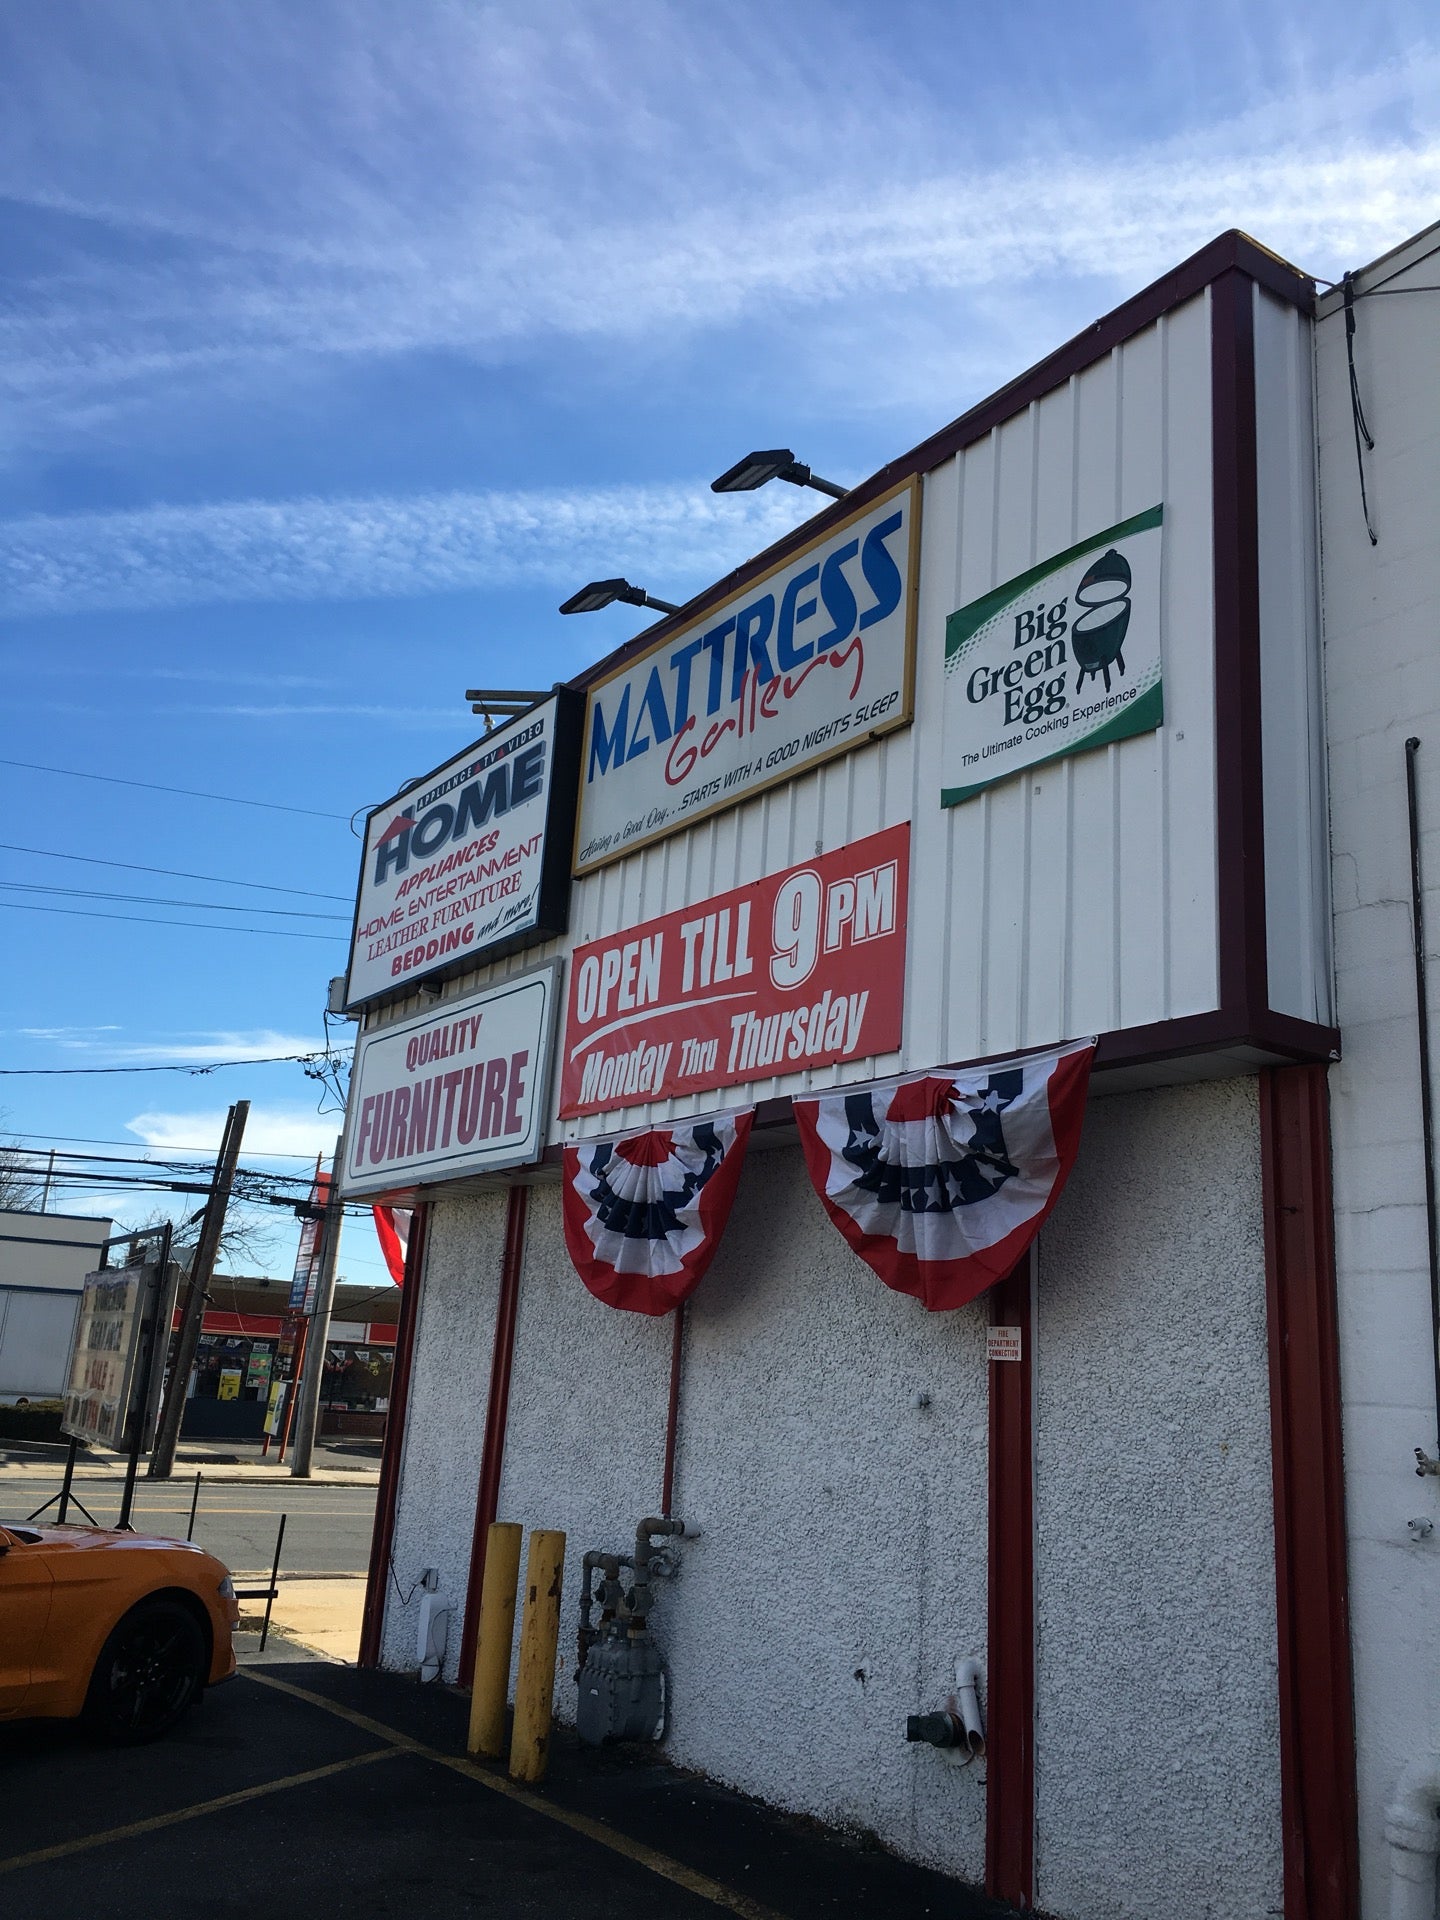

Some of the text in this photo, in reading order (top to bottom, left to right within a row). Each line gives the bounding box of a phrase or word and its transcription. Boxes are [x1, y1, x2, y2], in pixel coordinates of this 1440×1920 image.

[588, 510, 902, 784] MATTRESS
[1013, 597, 1068, 650] Big
[665, 636, 864, 785] Gallery
[966, 640, 1067, 704] Green
[1003, 671, 1067, 726] Egg
[418, 722, 542, 808] APPLIANCE TV VIDEO
[961, 687, 1137, 767] The Ultimate Cooking Experience
[374, 740, 547, 887] HOME
[579, 833, 613, 862] Having
[613, 831, 621, 845] a
[622, 815, 646, 839] Good
[723, 761, 751, 790] WITH
[753, 757, 762, 775] A
[765, 739, 801, 769] GOOD
[853, 690, 900, 727] SLEEP
[357, 832, 543, 943] HOME ENTERTAINMENT
[395, 829, 500, 901] APPLIANCES
[366, 870, 523, 963] LEATHER FURNITURE
[391, 921, 475, 977] BEDDING
[477, 906, 504, 939] and
[577, 932, 664, 1024] OPEN
[680, 900, 753, 994] TILL
[405, 1013, 484, 1073] QUALITY
[577, 988, 870, 1106] Monday Thru Thursday
[355, 1049, 530, 1169] FURNITURE
